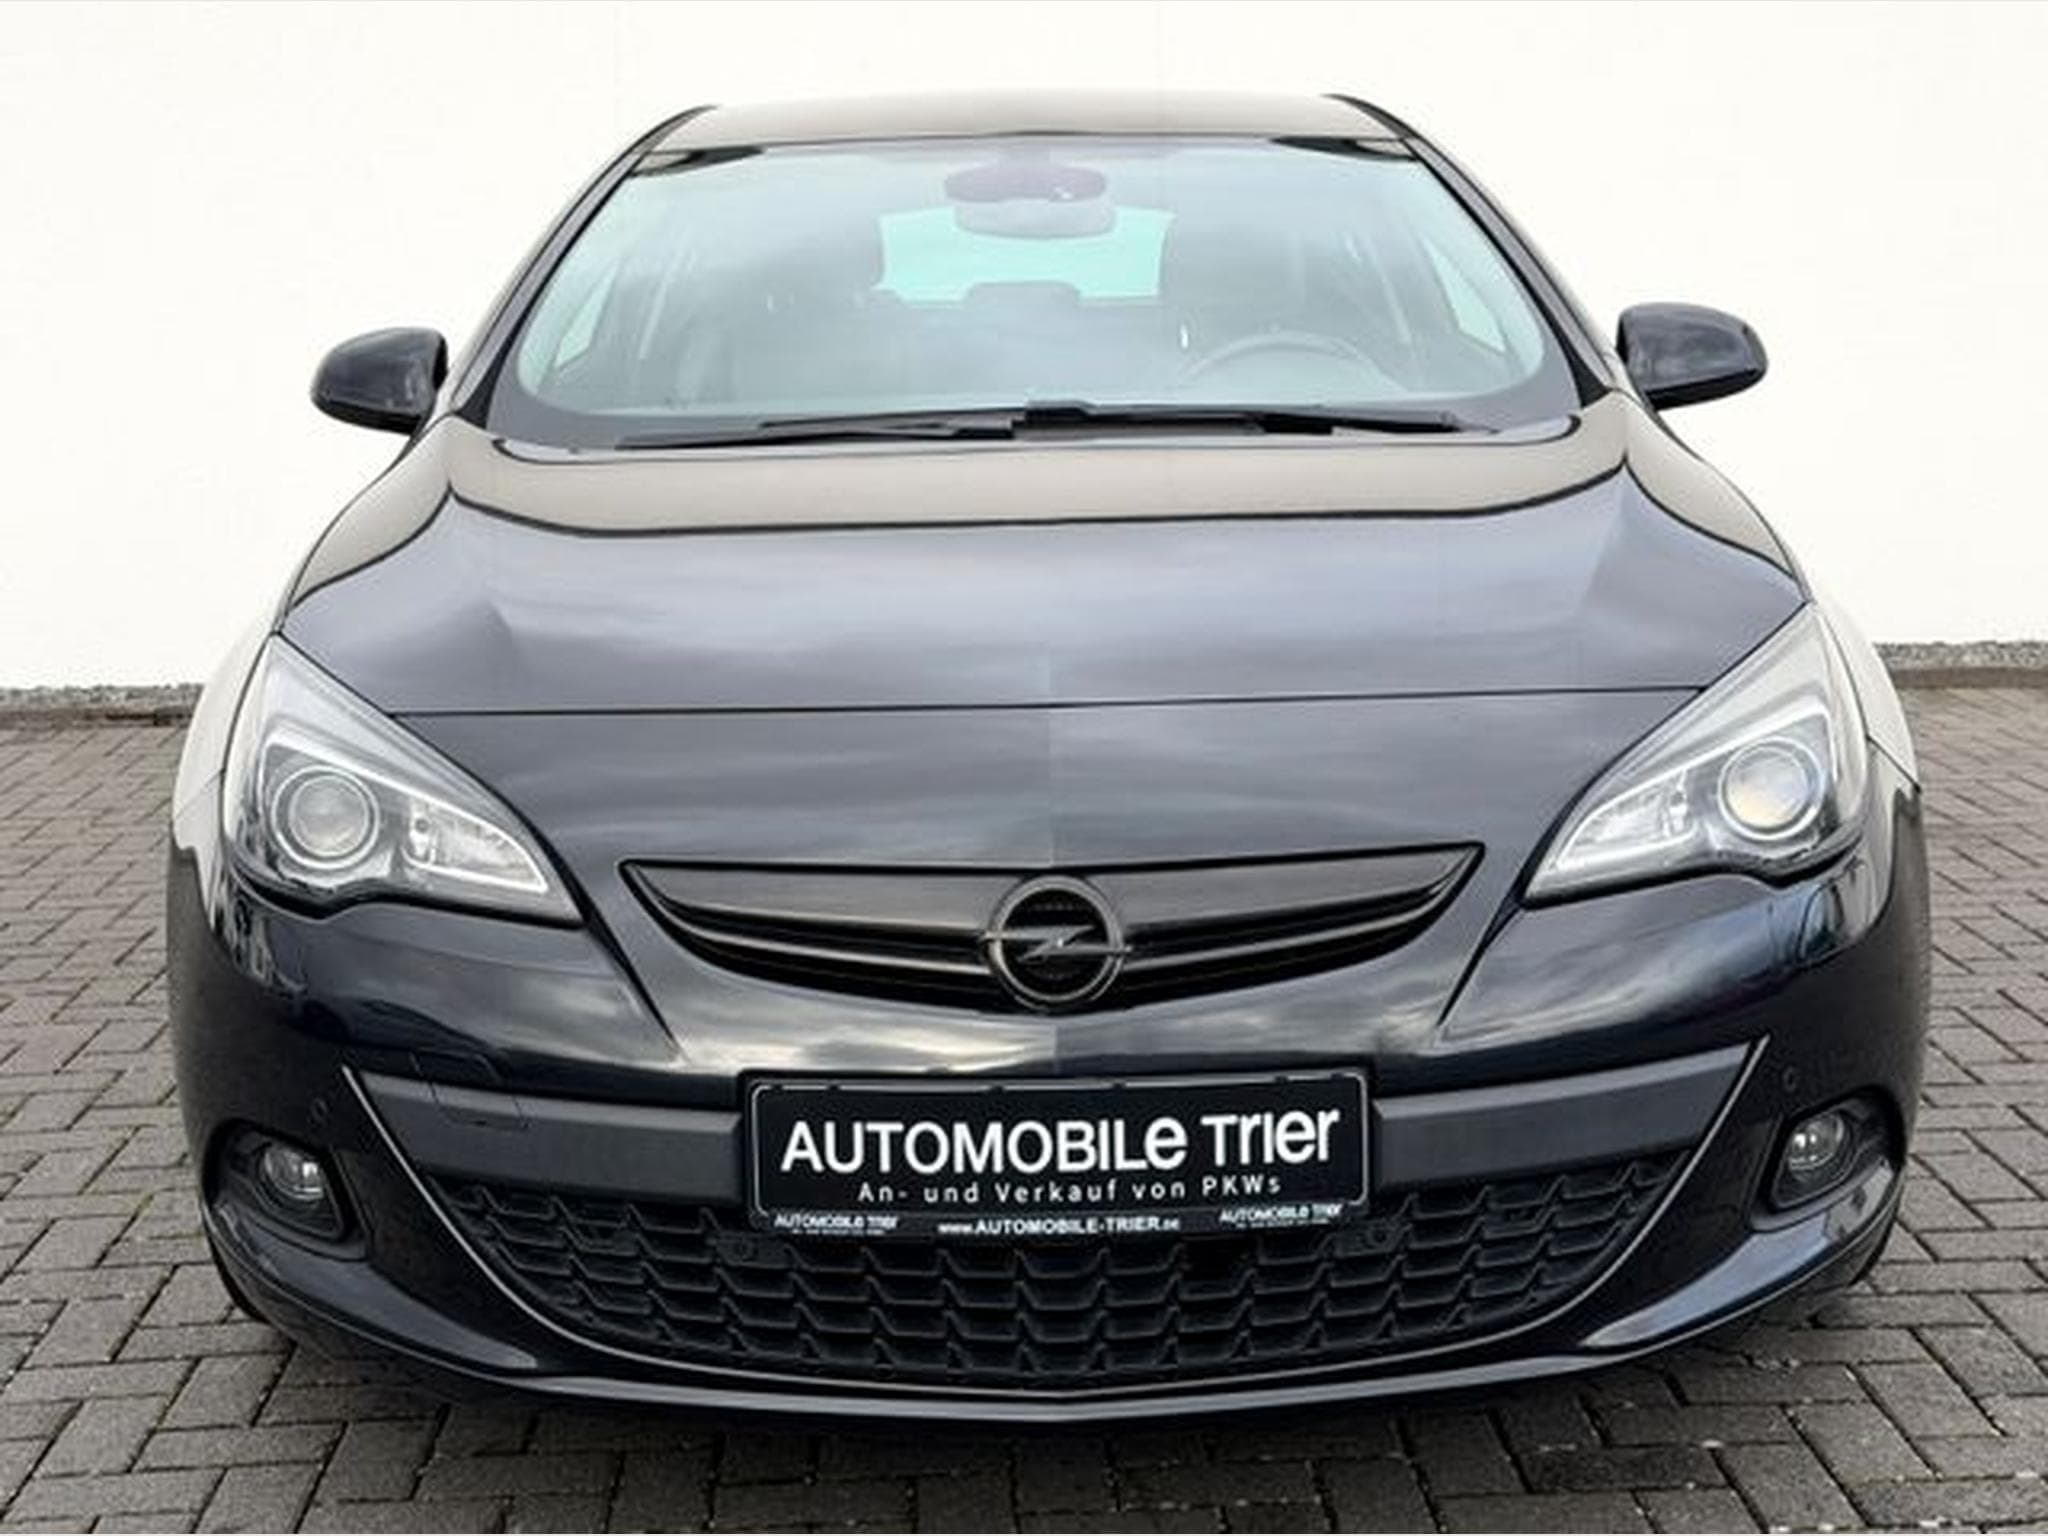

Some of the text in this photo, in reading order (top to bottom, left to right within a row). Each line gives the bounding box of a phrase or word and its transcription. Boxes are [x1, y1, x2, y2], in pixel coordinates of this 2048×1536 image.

[780, 1116, 1188, 1174] AUTOMOBILe
[858, 1174, 1281, 1203] An- und Verkauf von PKWs
